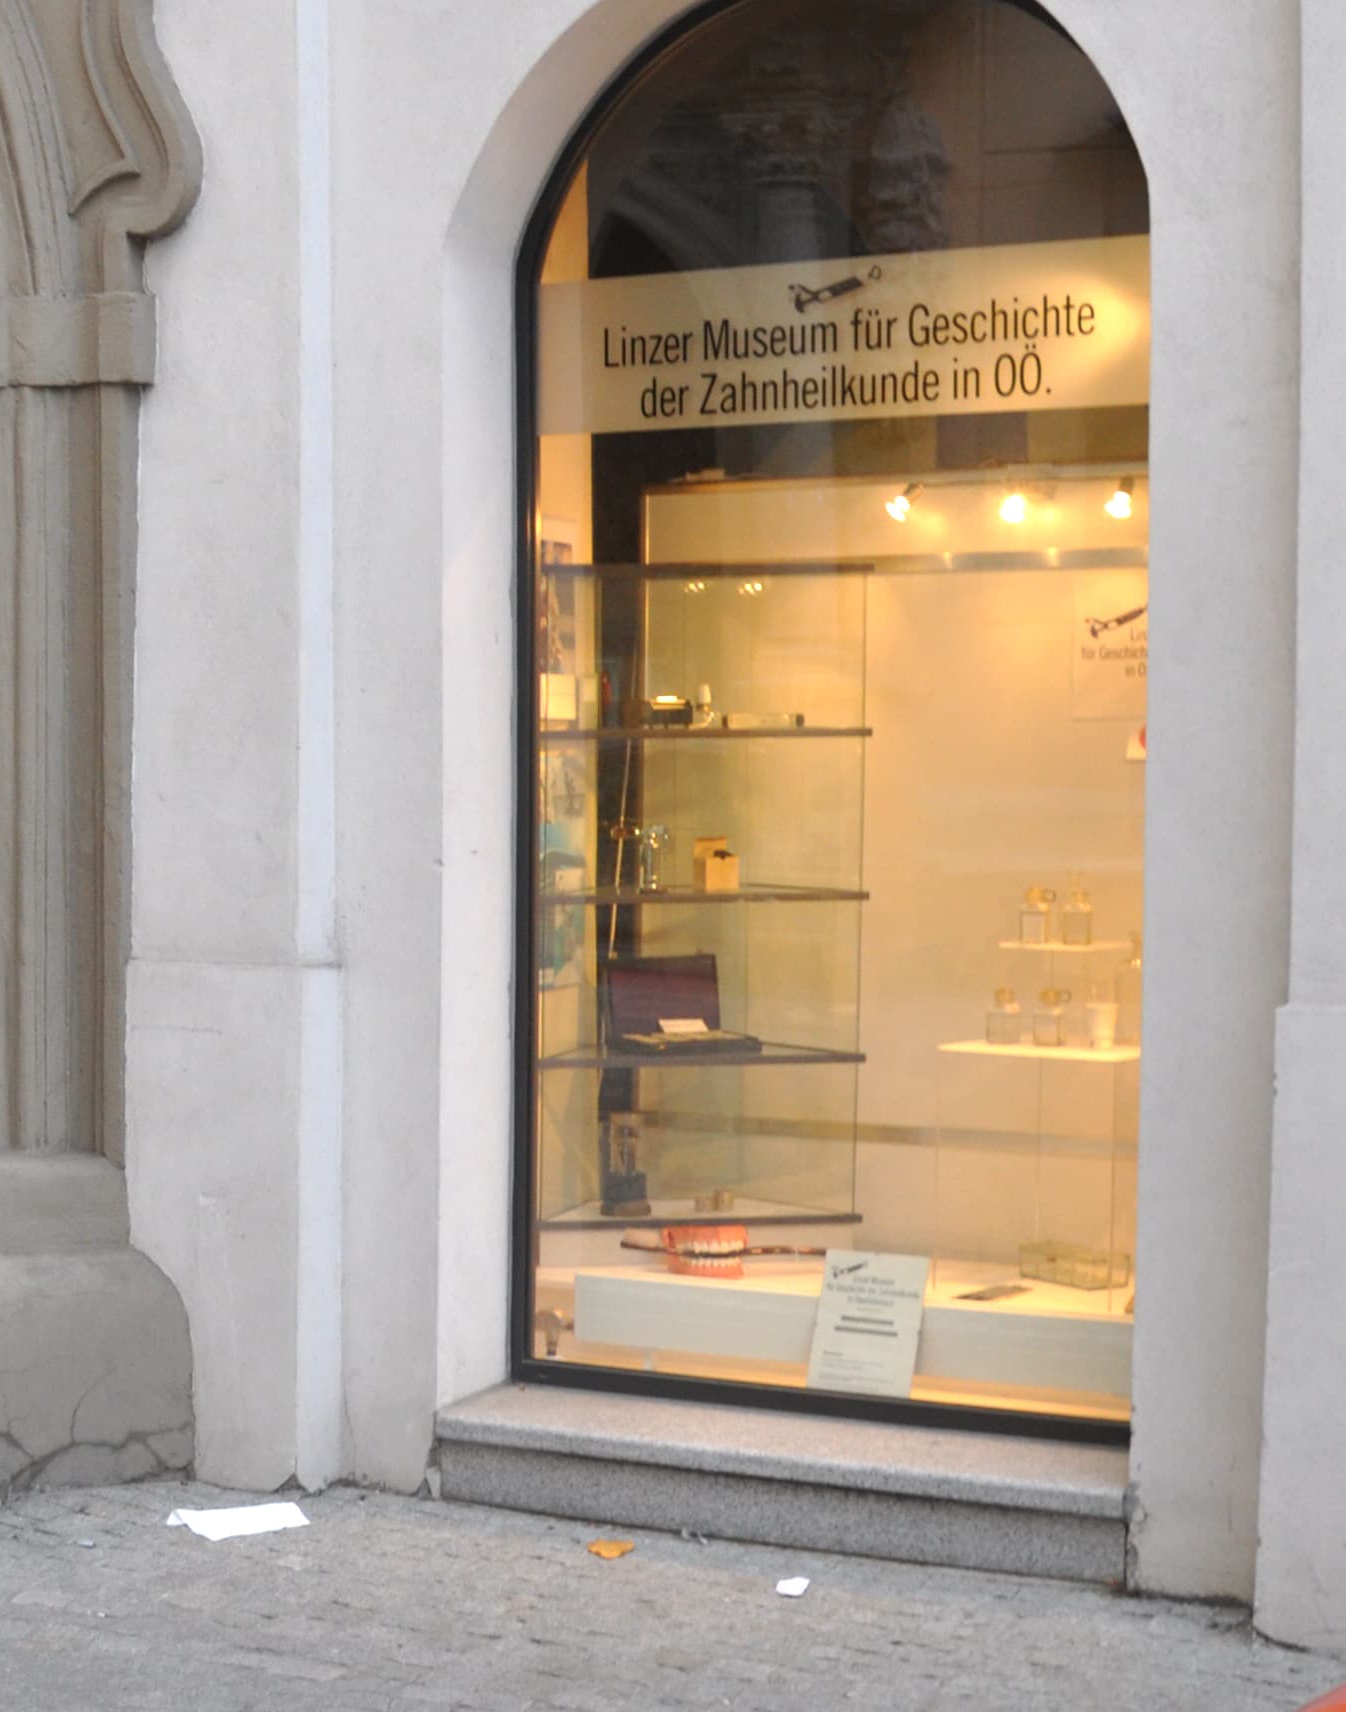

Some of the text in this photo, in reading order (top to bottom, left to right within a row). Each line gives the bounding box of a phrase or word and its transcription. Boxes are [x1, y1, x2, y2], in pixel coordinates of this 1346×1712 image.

[604, 293, 1095, 368] Linzer Museum für Geschichte
[640, 343, 1052, 418] der Zahnheilkunde in OÖ.
